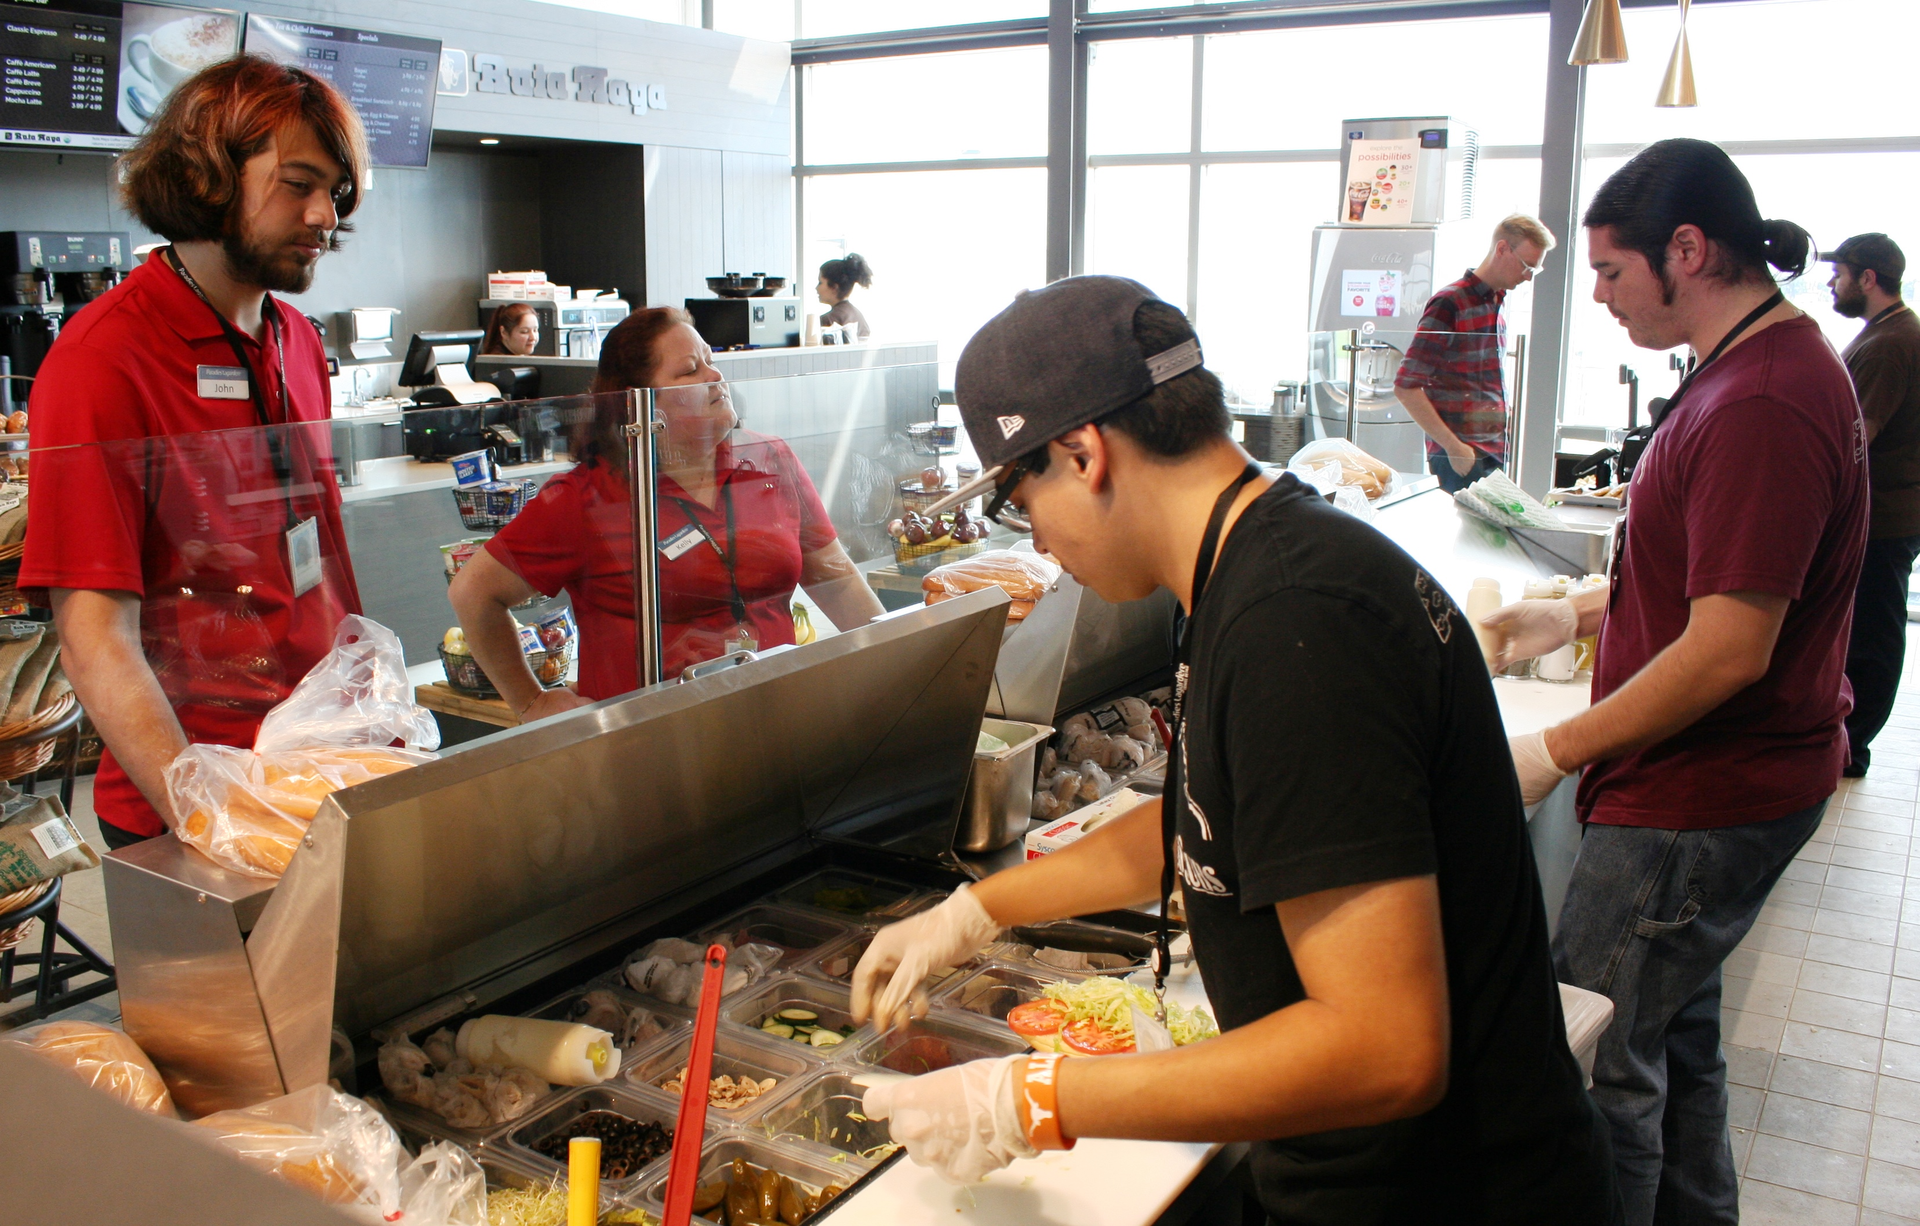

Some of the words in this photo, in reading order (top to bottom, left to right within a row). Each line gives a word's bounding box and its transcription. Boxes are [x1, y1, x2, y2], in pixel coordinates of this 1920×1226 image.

[7, 25, 29, 34] Classic
[30, 28, 58, 36] Espresso
[357, 33, 378, 42] Specials
[24, 60, 56, 70] Americano
[473, 53, 568, 100] Ruta
[572, 65, 667, 116] Maya
[5, 87, 41, 96] Cappuccino
[5, 96, 25, 104] Mocha
[15, 133, 36, 141] Ruta
[38, 134, 61, 142] Maya
[1358, 153, 1412, 162] possibilities
[215, 384, 234, 393] John
[676, 539, 692, 550] Kelly
[1037, 843, 1055, 854] Sysco
